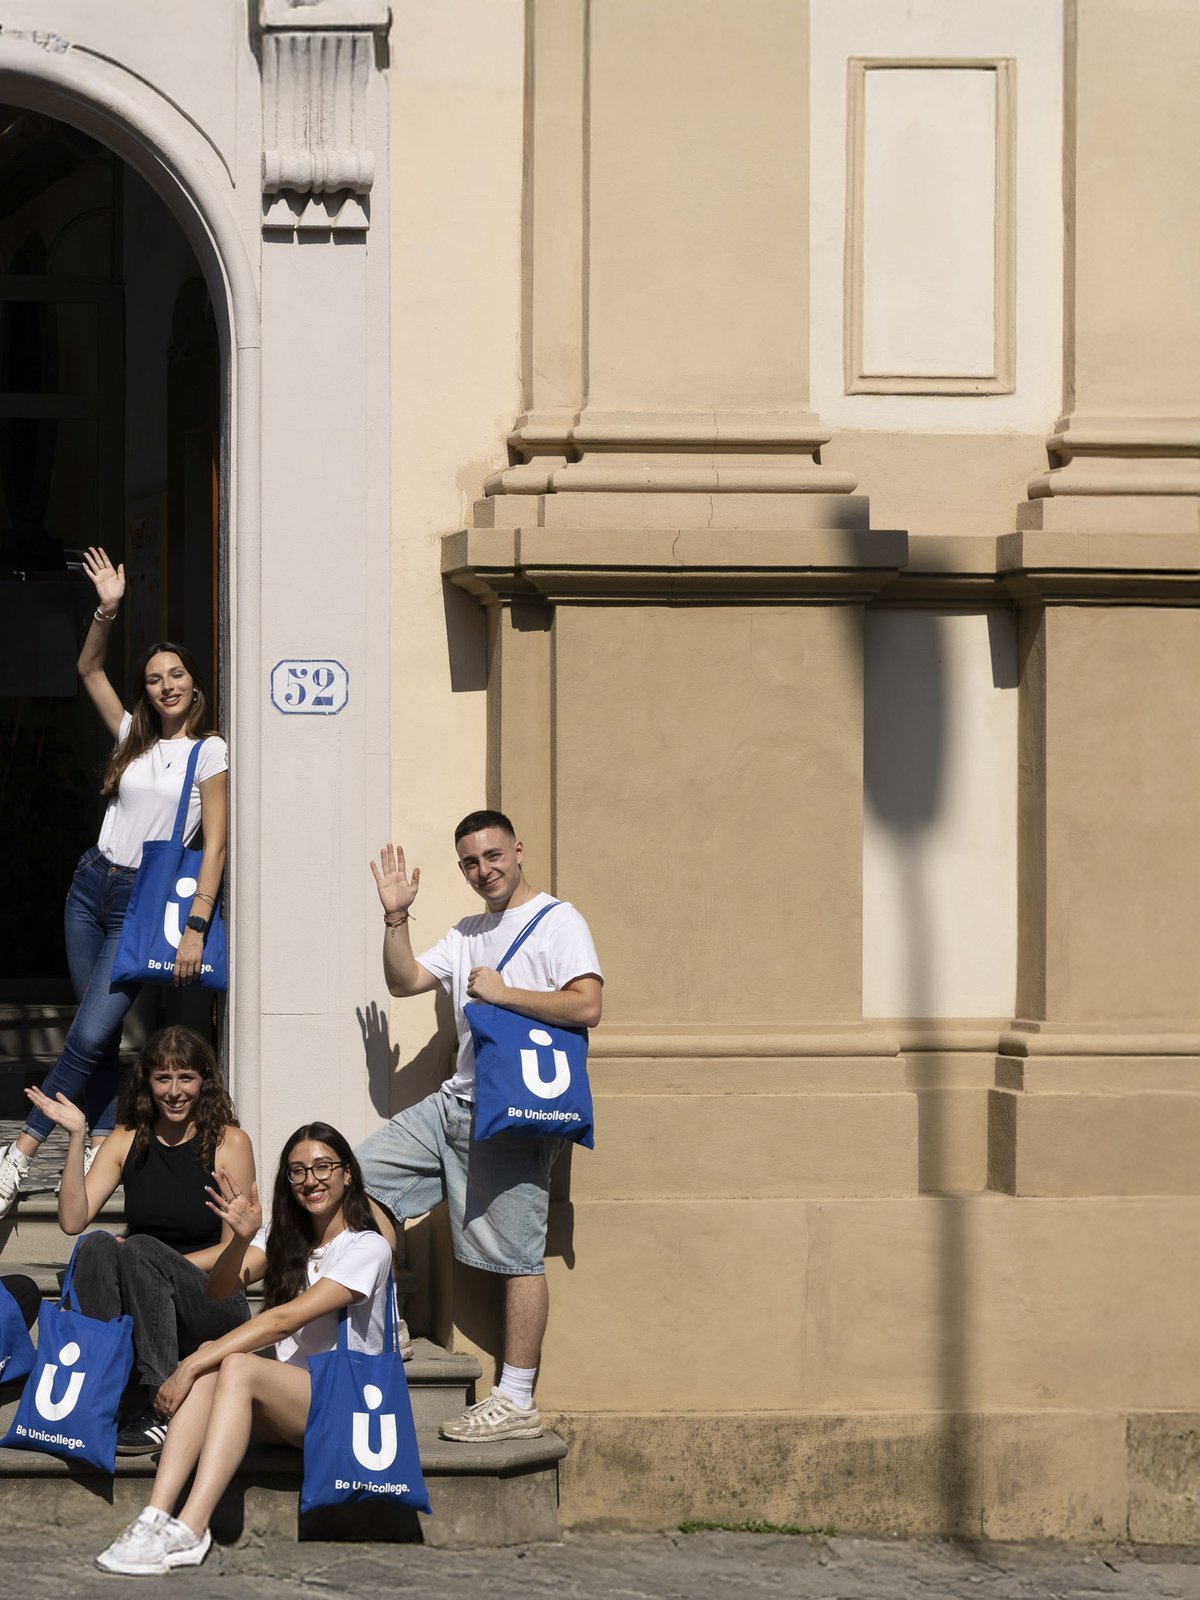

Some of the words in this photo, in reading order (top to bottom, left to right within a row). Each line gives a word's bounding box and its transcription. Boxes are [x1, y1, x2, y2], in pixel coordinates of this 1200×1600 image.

[284, 668, 335, 706] 52
[147, 959, 162, 970] Be
[507, 1107, 523, 1118] Be
[524, 1109, 582, 1123] Unicollege.
[15, 1424, 27, 1437] Be
[28, 1428, 86, 1450] Unicollege.
[335, 1479, 350, 1490] Be
[352, 1480, 410, 1496] Unicollege.
